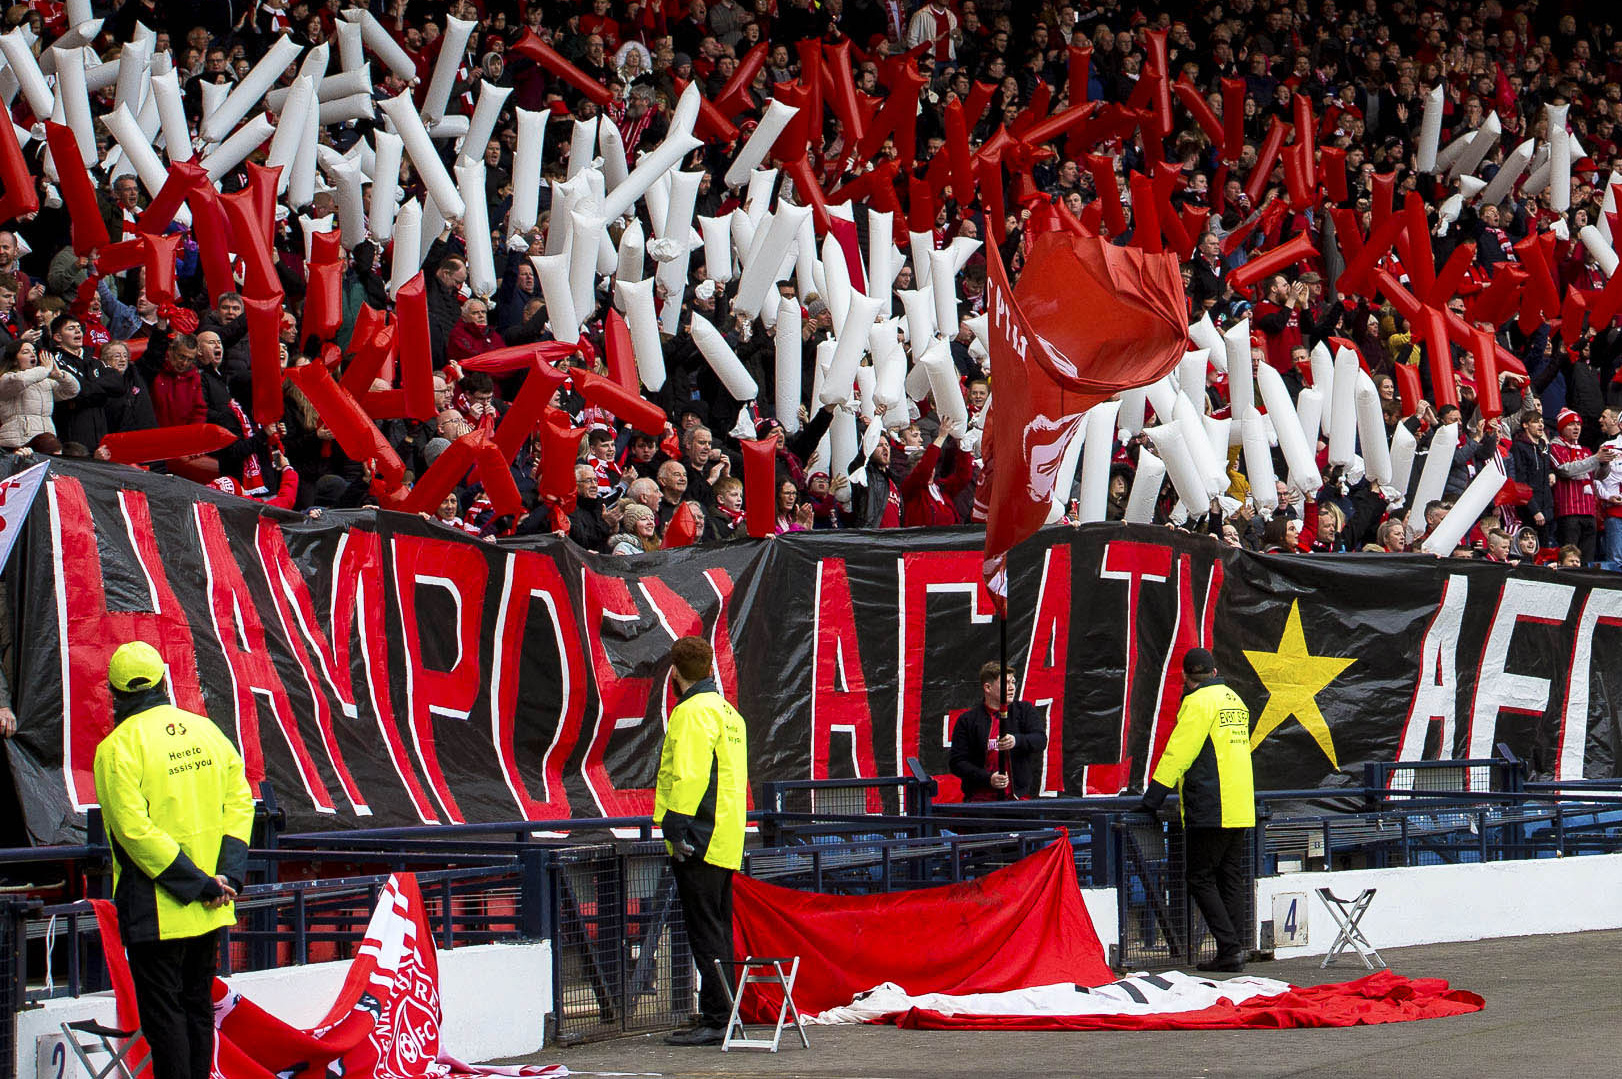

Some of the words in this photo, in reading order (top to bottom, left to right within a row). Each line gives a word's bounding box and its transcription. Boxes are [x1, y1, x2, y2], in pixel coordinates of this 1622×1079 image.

[46, 475, 759, 838] HAMPDEN
[194, 759, 212, 770] you
[1284, 898, 1298, 941] 4
[415, 1022, 437, 1047] FC
